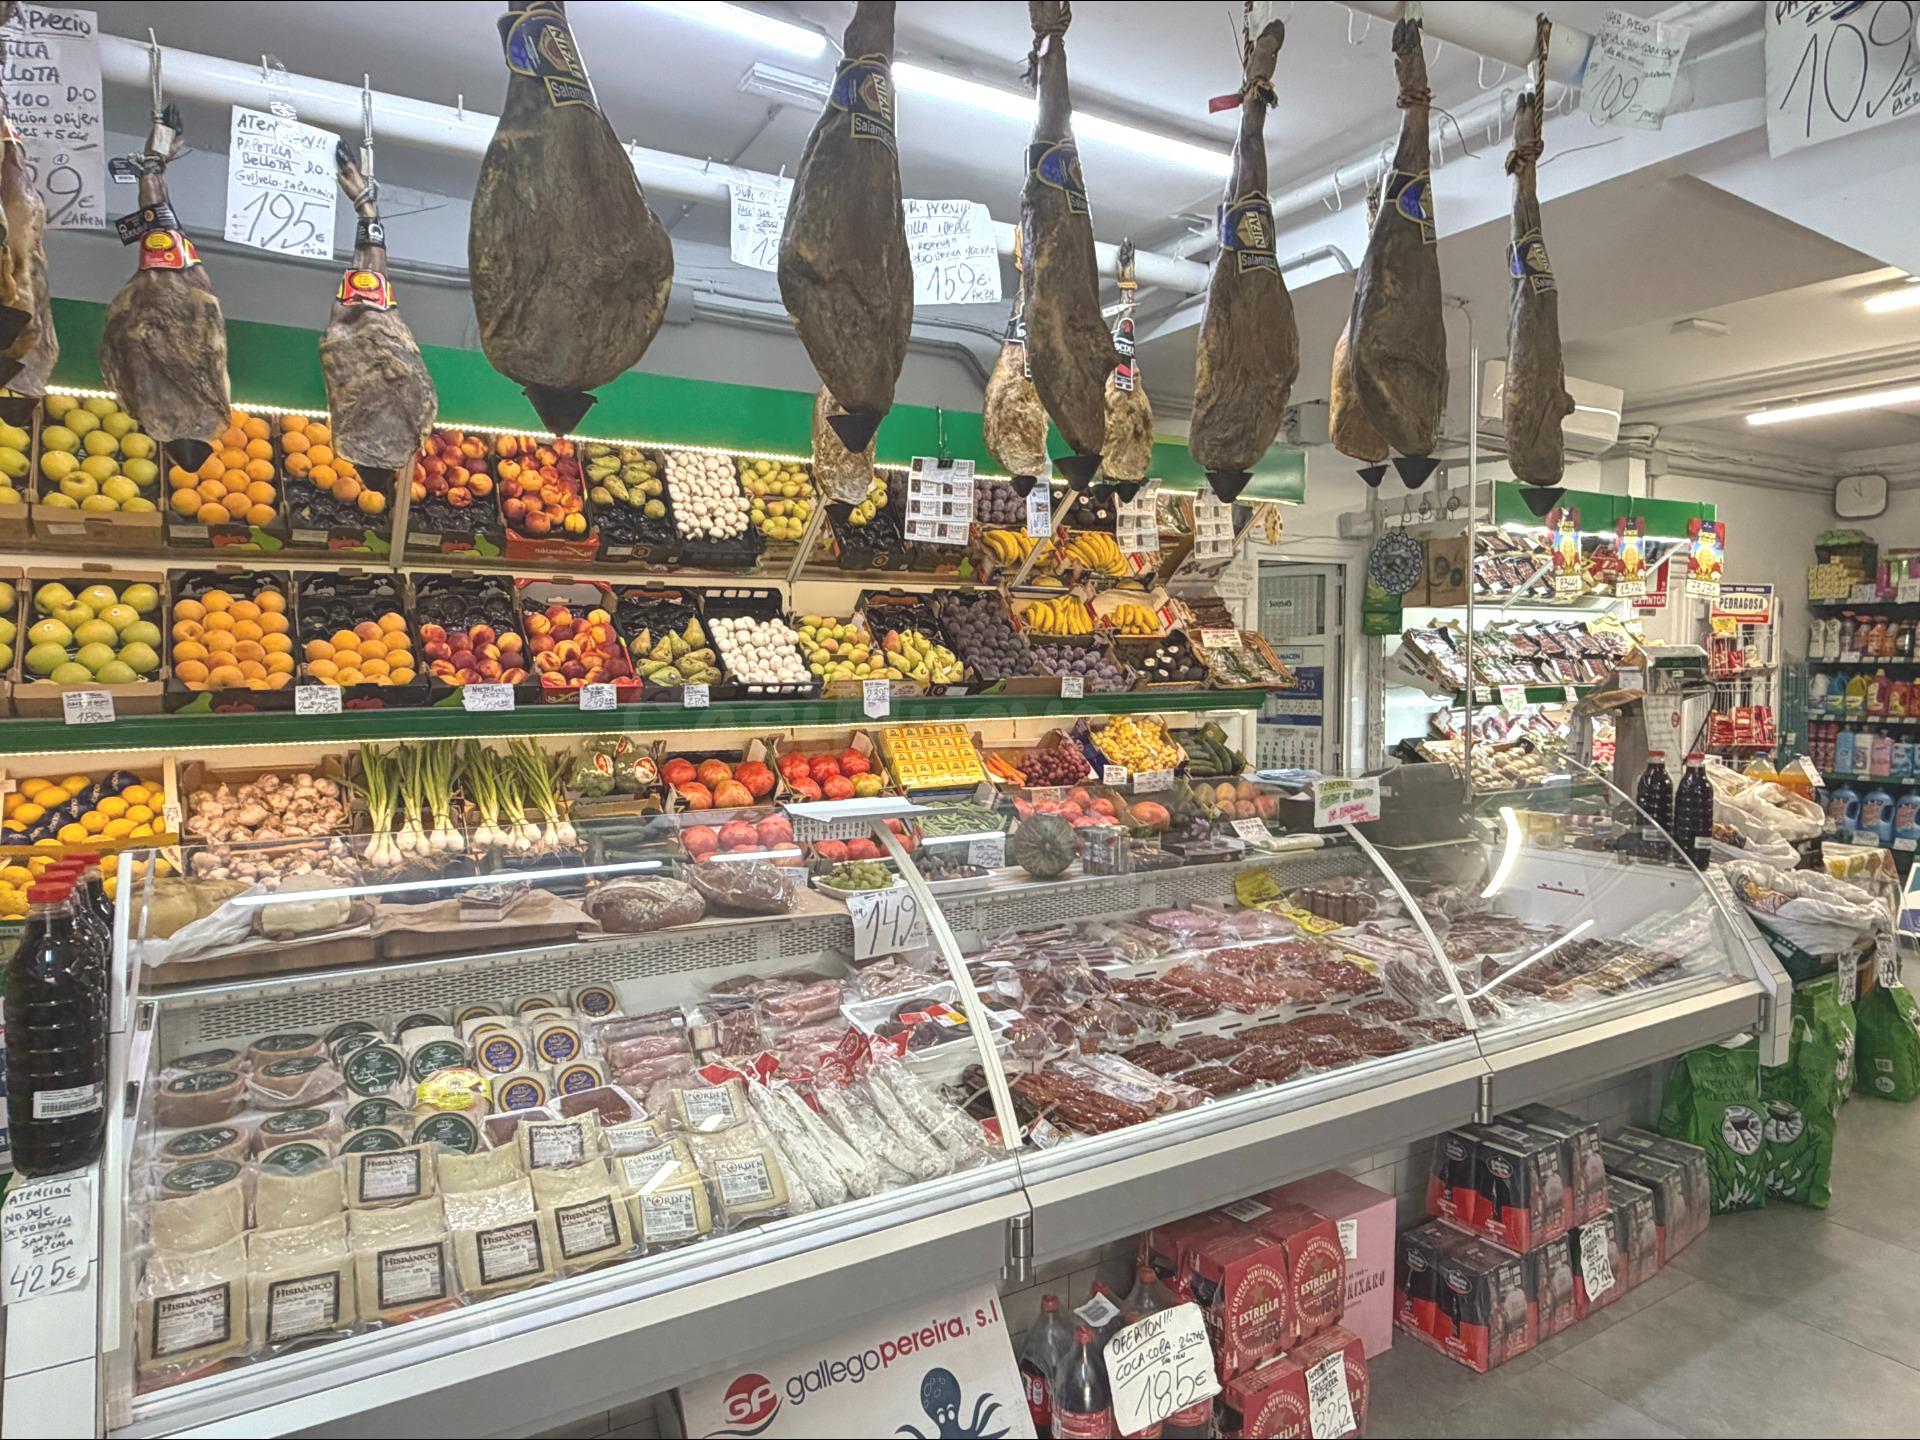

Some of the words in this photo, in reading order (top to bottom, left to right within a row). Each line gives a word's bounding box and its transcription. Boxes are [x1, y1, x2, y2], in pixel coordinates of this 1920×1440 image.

[1719, 597, 1764, 610] PEDRAGOSA
[1300, 1268, 1337, 1295] ESTRELLA
[1238, 1297, 1280, 1326] ESTRELLA
